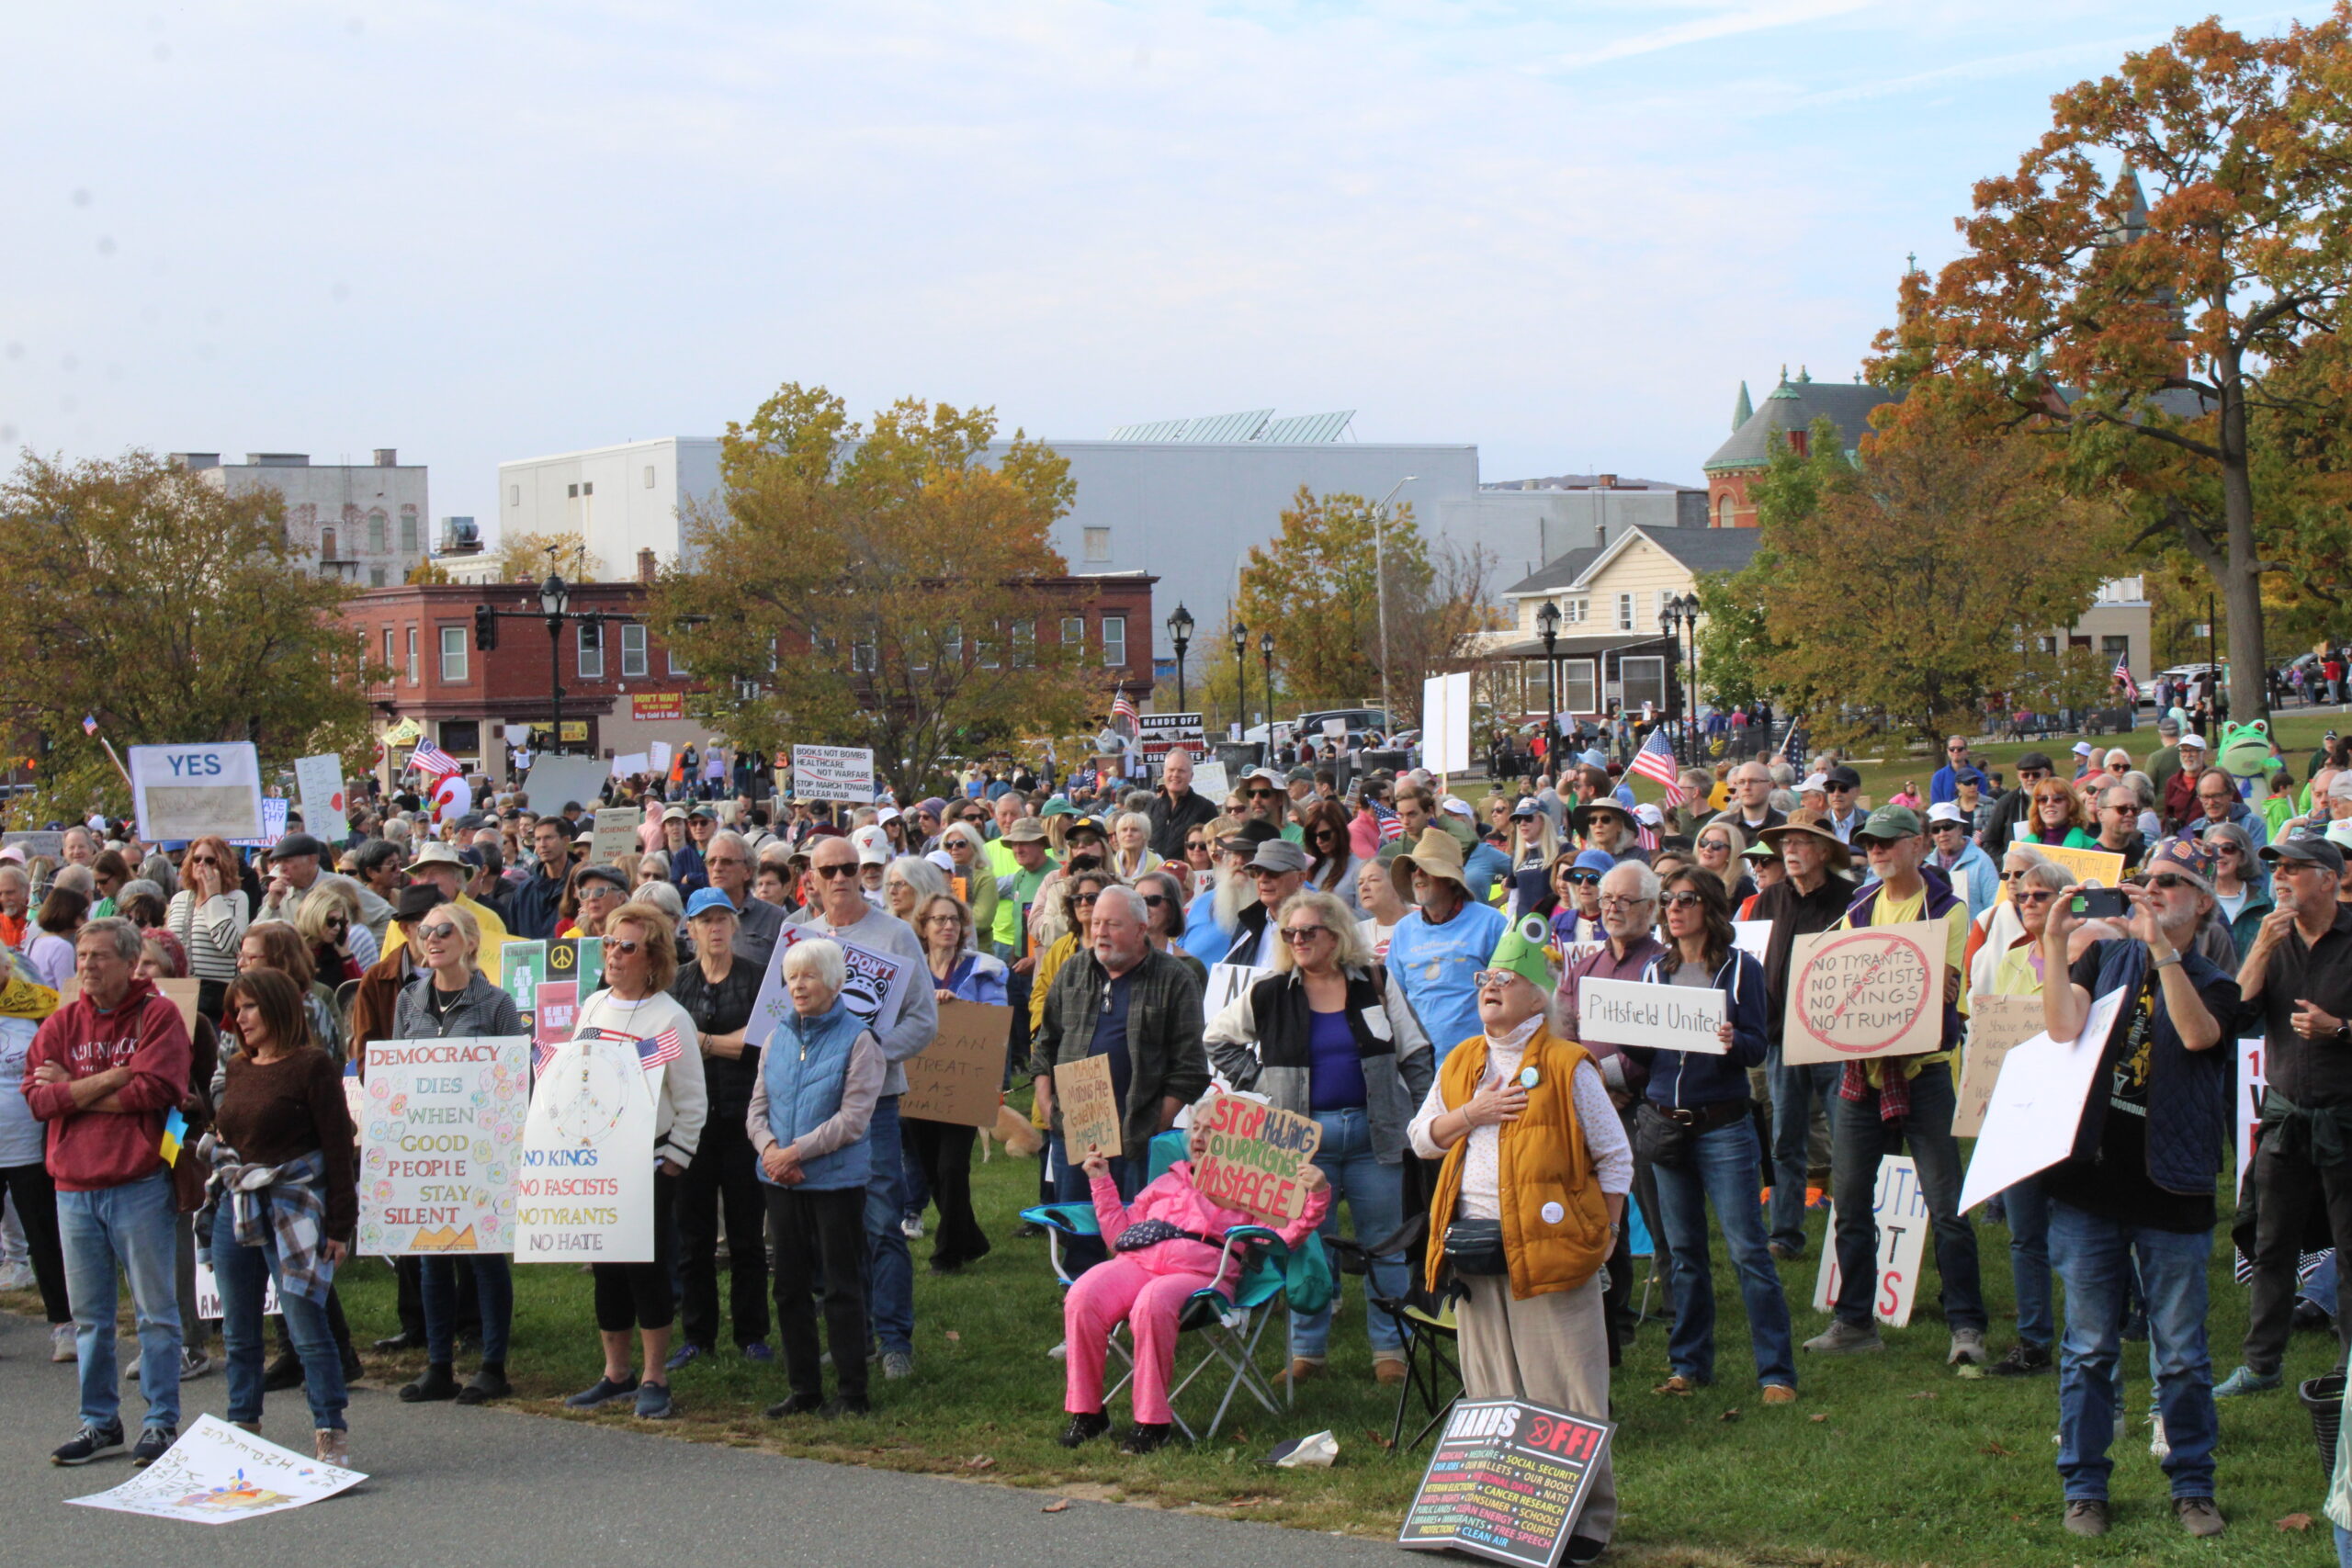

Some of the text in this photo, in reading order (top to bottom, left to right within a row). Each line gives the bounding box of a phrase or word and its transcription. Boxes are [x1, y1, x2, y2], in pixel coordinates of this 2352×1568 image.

[634, 693, 679, 703] DON'T WAIT
[1143, 716, 1199, 727] HANDS OFF
[796, 748, 867, 760] BOOKS NOT BOMBS
[797, 759, 845, 768] HEALTHCARE
[1147, 753, 1165, 761] OUR
[167, 753, 221, 776] YES
[834, 771, 870, 779] WARFARE
[797, 789, 831, 797] NUCLEAR
[815, 781, 842, 789] MARCH
[843, 783, 873, 792] TOWARD
[599, 825, 633, 834] SCIENCE
[783, 928, 802, 948] I
[847, 953, 895, 976] DON'T
[1813, 950, 1914, 972] NO TYRANTS
[1812, 967, 1926, 991] NO FASCISTS
[1810, 986, 1918, 1010] NO KINGS
[1589, 994, 1722, 1032] Pittsfield United
[1811, 1008, 1917, 1030] NO TRUMP
[368, 1045, 501, 1066] DEMOCRACY
[915, 1056, 971, 1076] TREAT
[416, 1077, 463, 1094] DIES
[406, 1107, 475, 1124] WHEN
[1210, 1099, 1265, 1141] STOP
[400, 1134, 469, 1152] GOOD
[1210, 1134, 1250, 1165] OUR
[523, 1149, 598, 1167] NO KINGS
[388, 1159, 467, 1178] PEOPLE
[419, 1185, 472, 1202] STAY
[518, 1178, 618, 1196] NO FASCISTS
[384, 1207, 460, 1224] SILENT
[516, 1207, 618, 1225] NO TYRANTS
[529, 1234, 603, 1251] NO HATE
[1448, 1406, 1600, 1461] HANDS OFF!
[1469, 1450, 1499, 1461] MEDICARE
[1505, 1454, 1536, 1471] SOCIAL
[1537, 1463, 1580, 1483] SECURITY
[1445, 1461, 1461, 1471] JOBS
[1476, 1461, 1513, 1476] WALLETS
[1523, 1472, 1544, 1485] OUR
[1544, 1477, 1576, 1494] BOOKS
[1484, 1485, 1519, 1503] CANCER
[1519, 1495, 1566, 1516] RESEARCH
[1510, 1480, 1535, 1495] DATA
[1543, 1490, 1570, 1505] NATO
[1464, 1493, 1510, 1513] CONSUMER
[1518, 1507, 1561, 1528] SCHOOLS
[1416, 1504, 1557, 1538] PUBLIC LANDS CLEAN ENERGY COURTS
[1410, 1514, 1553, 1549] LIBRARIES IMMIGRANTS FREE SPEECH
[1419, 1524, 1510, 1548] PROTECTIONS CLEAN AIR
